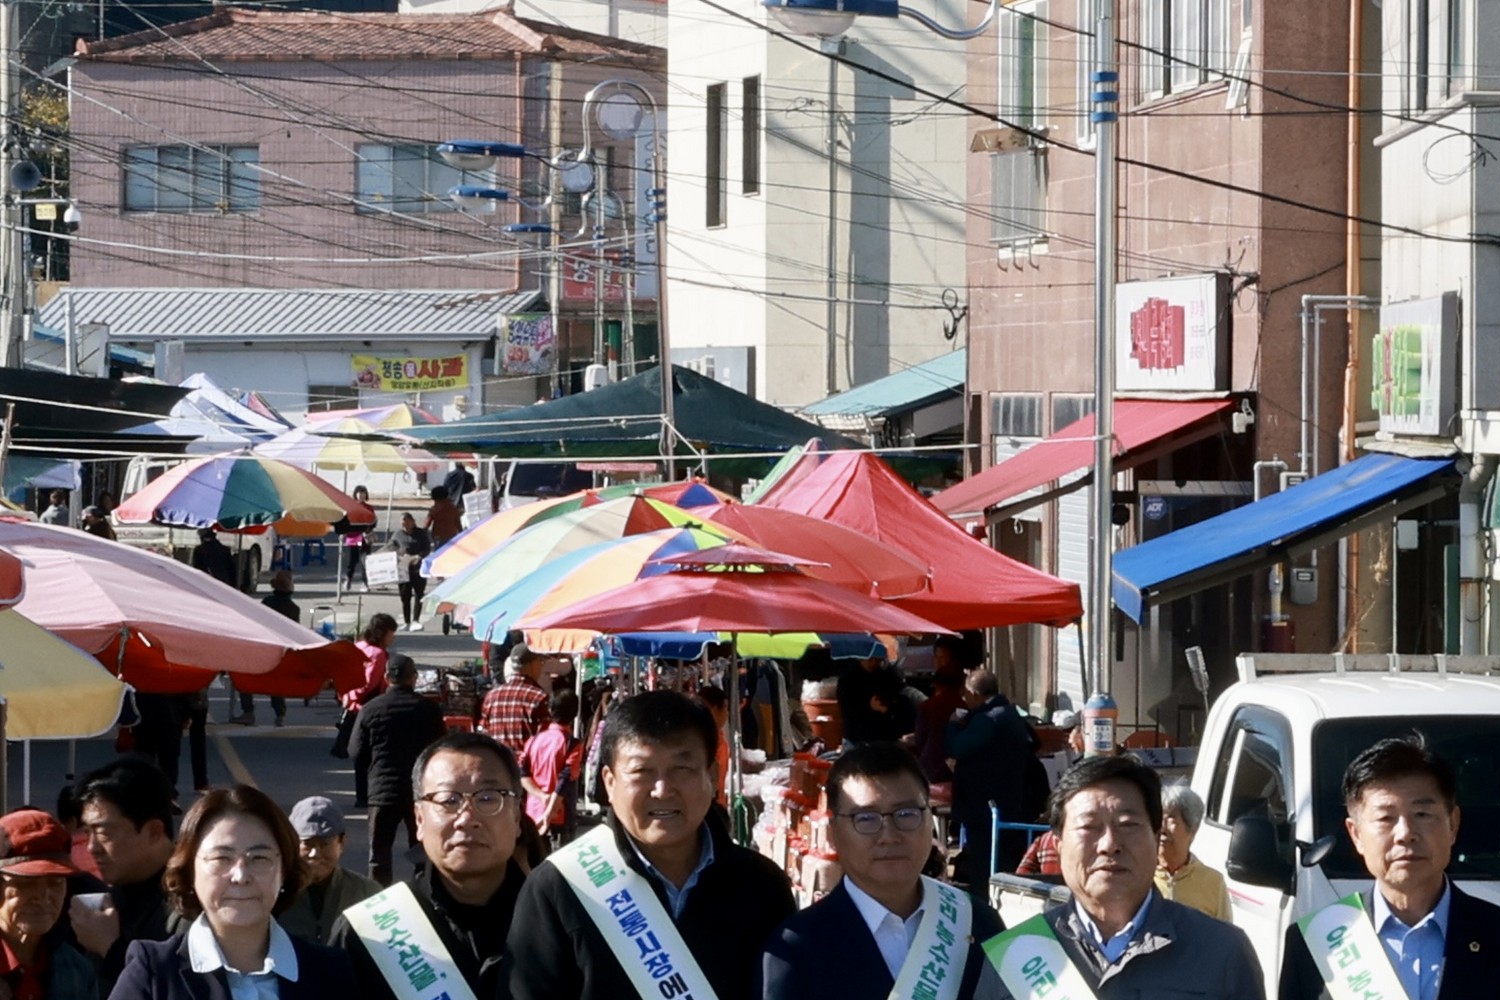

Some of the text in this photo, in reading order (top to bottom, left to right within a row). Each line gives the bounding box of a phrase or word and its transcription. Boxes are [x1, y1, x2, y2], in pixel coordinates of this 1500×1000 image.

[1146, 502, 1163, 512] ADT
[372, 908, 447, 993] 농수산물,
[1326, 924, 1362, 970] 우리
[1022, 955, 1058, 999] 우리
